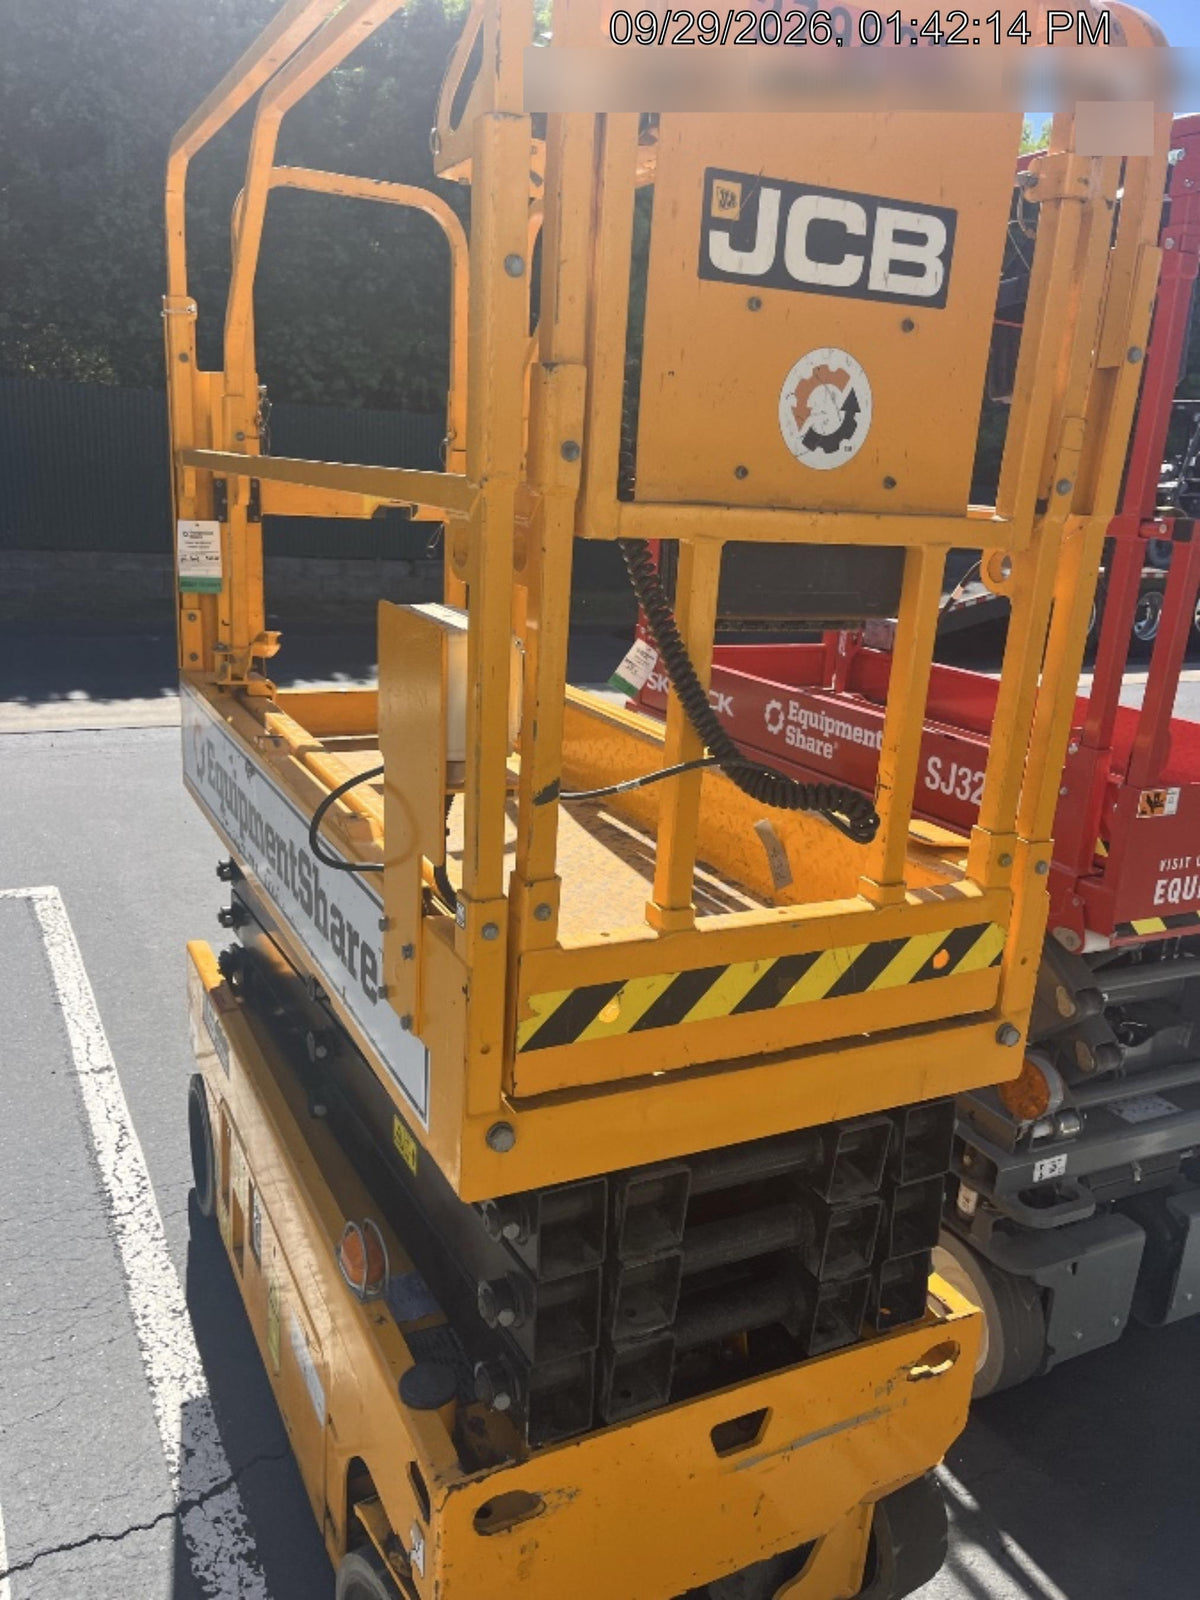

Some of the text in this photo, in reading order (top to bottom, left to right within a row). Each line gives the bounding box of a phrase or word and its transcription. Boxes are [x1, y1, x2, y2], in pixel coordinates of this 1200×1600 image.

[708, 186, 947, 297] JCB
[787, 700, 884, 750] Equipment
[206, 736, 379, 1006] EquipmentShare
[1159, 856, 1193, 873] VISIT
[1153, 875, 1200, 906] EQU
